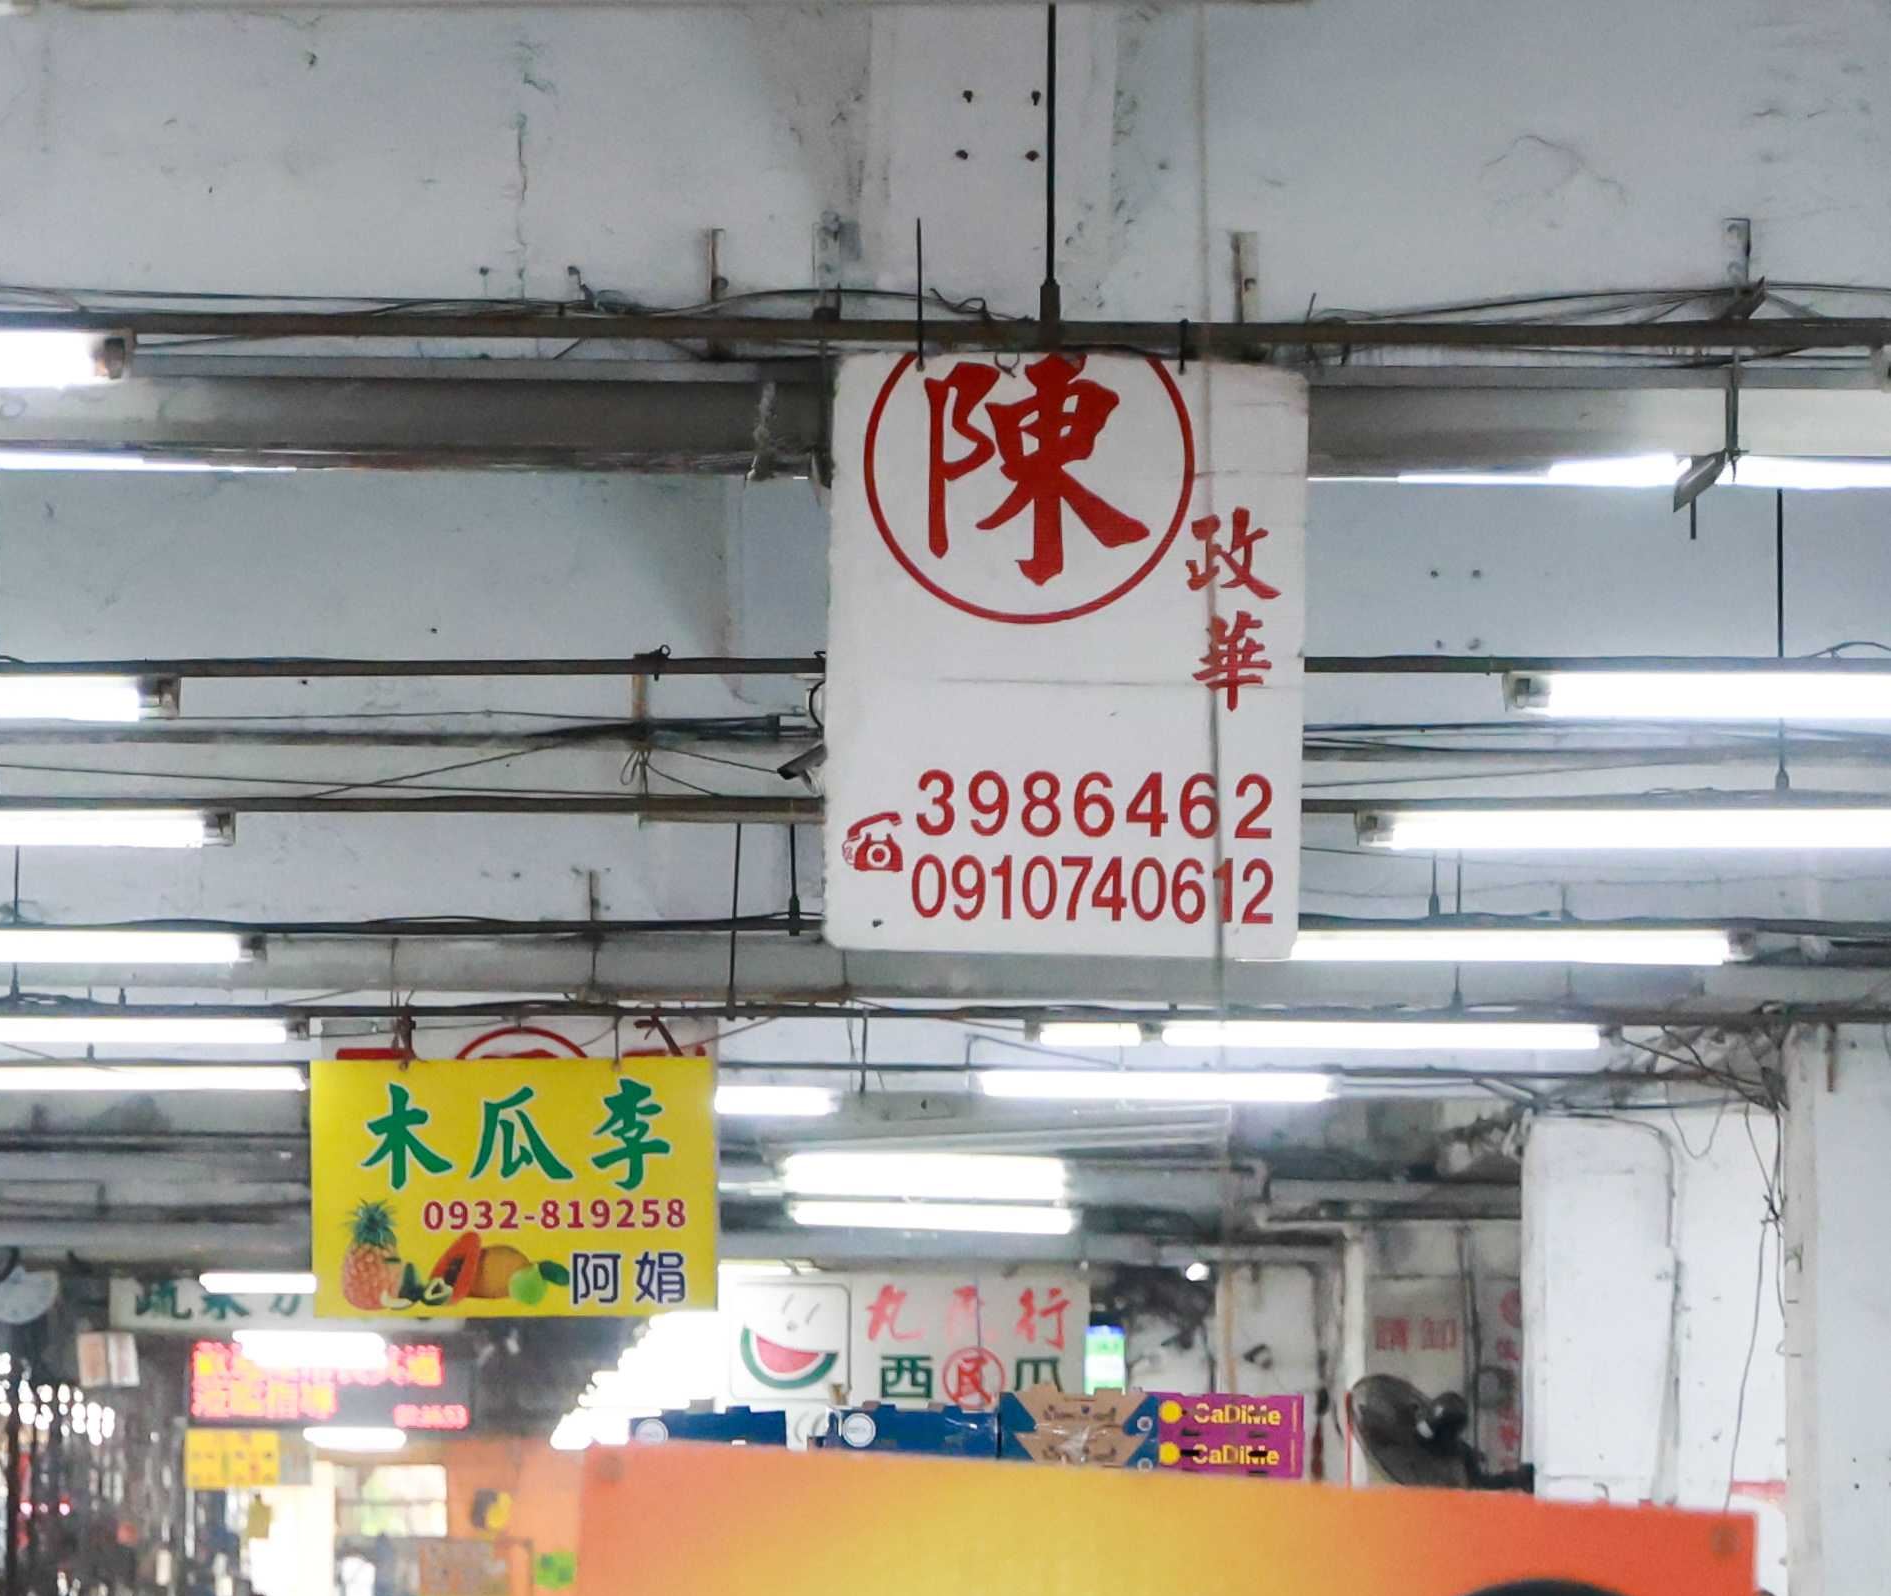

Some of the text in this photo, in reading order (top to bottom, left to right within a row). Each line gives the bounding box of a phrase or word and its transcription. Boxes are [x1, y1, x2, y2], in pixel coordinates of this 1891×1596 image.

[924, 353, 1150, 586] 陳
[1185, 506, 1281, 712] 政華
[916, 769, 1274, 840] 3986462
[911, 854, 1275, 925] 0910740612
[362, 1079, 673, 1191] 木瓜李
[423, 1200, 687, 1231] 0932-819258
[572, 1252, 687, 1305] 阿娟
[1193, 1402, 1282, 1426] CaDiMe
[1191, 1443, 1281, 1465] CaDiMe
